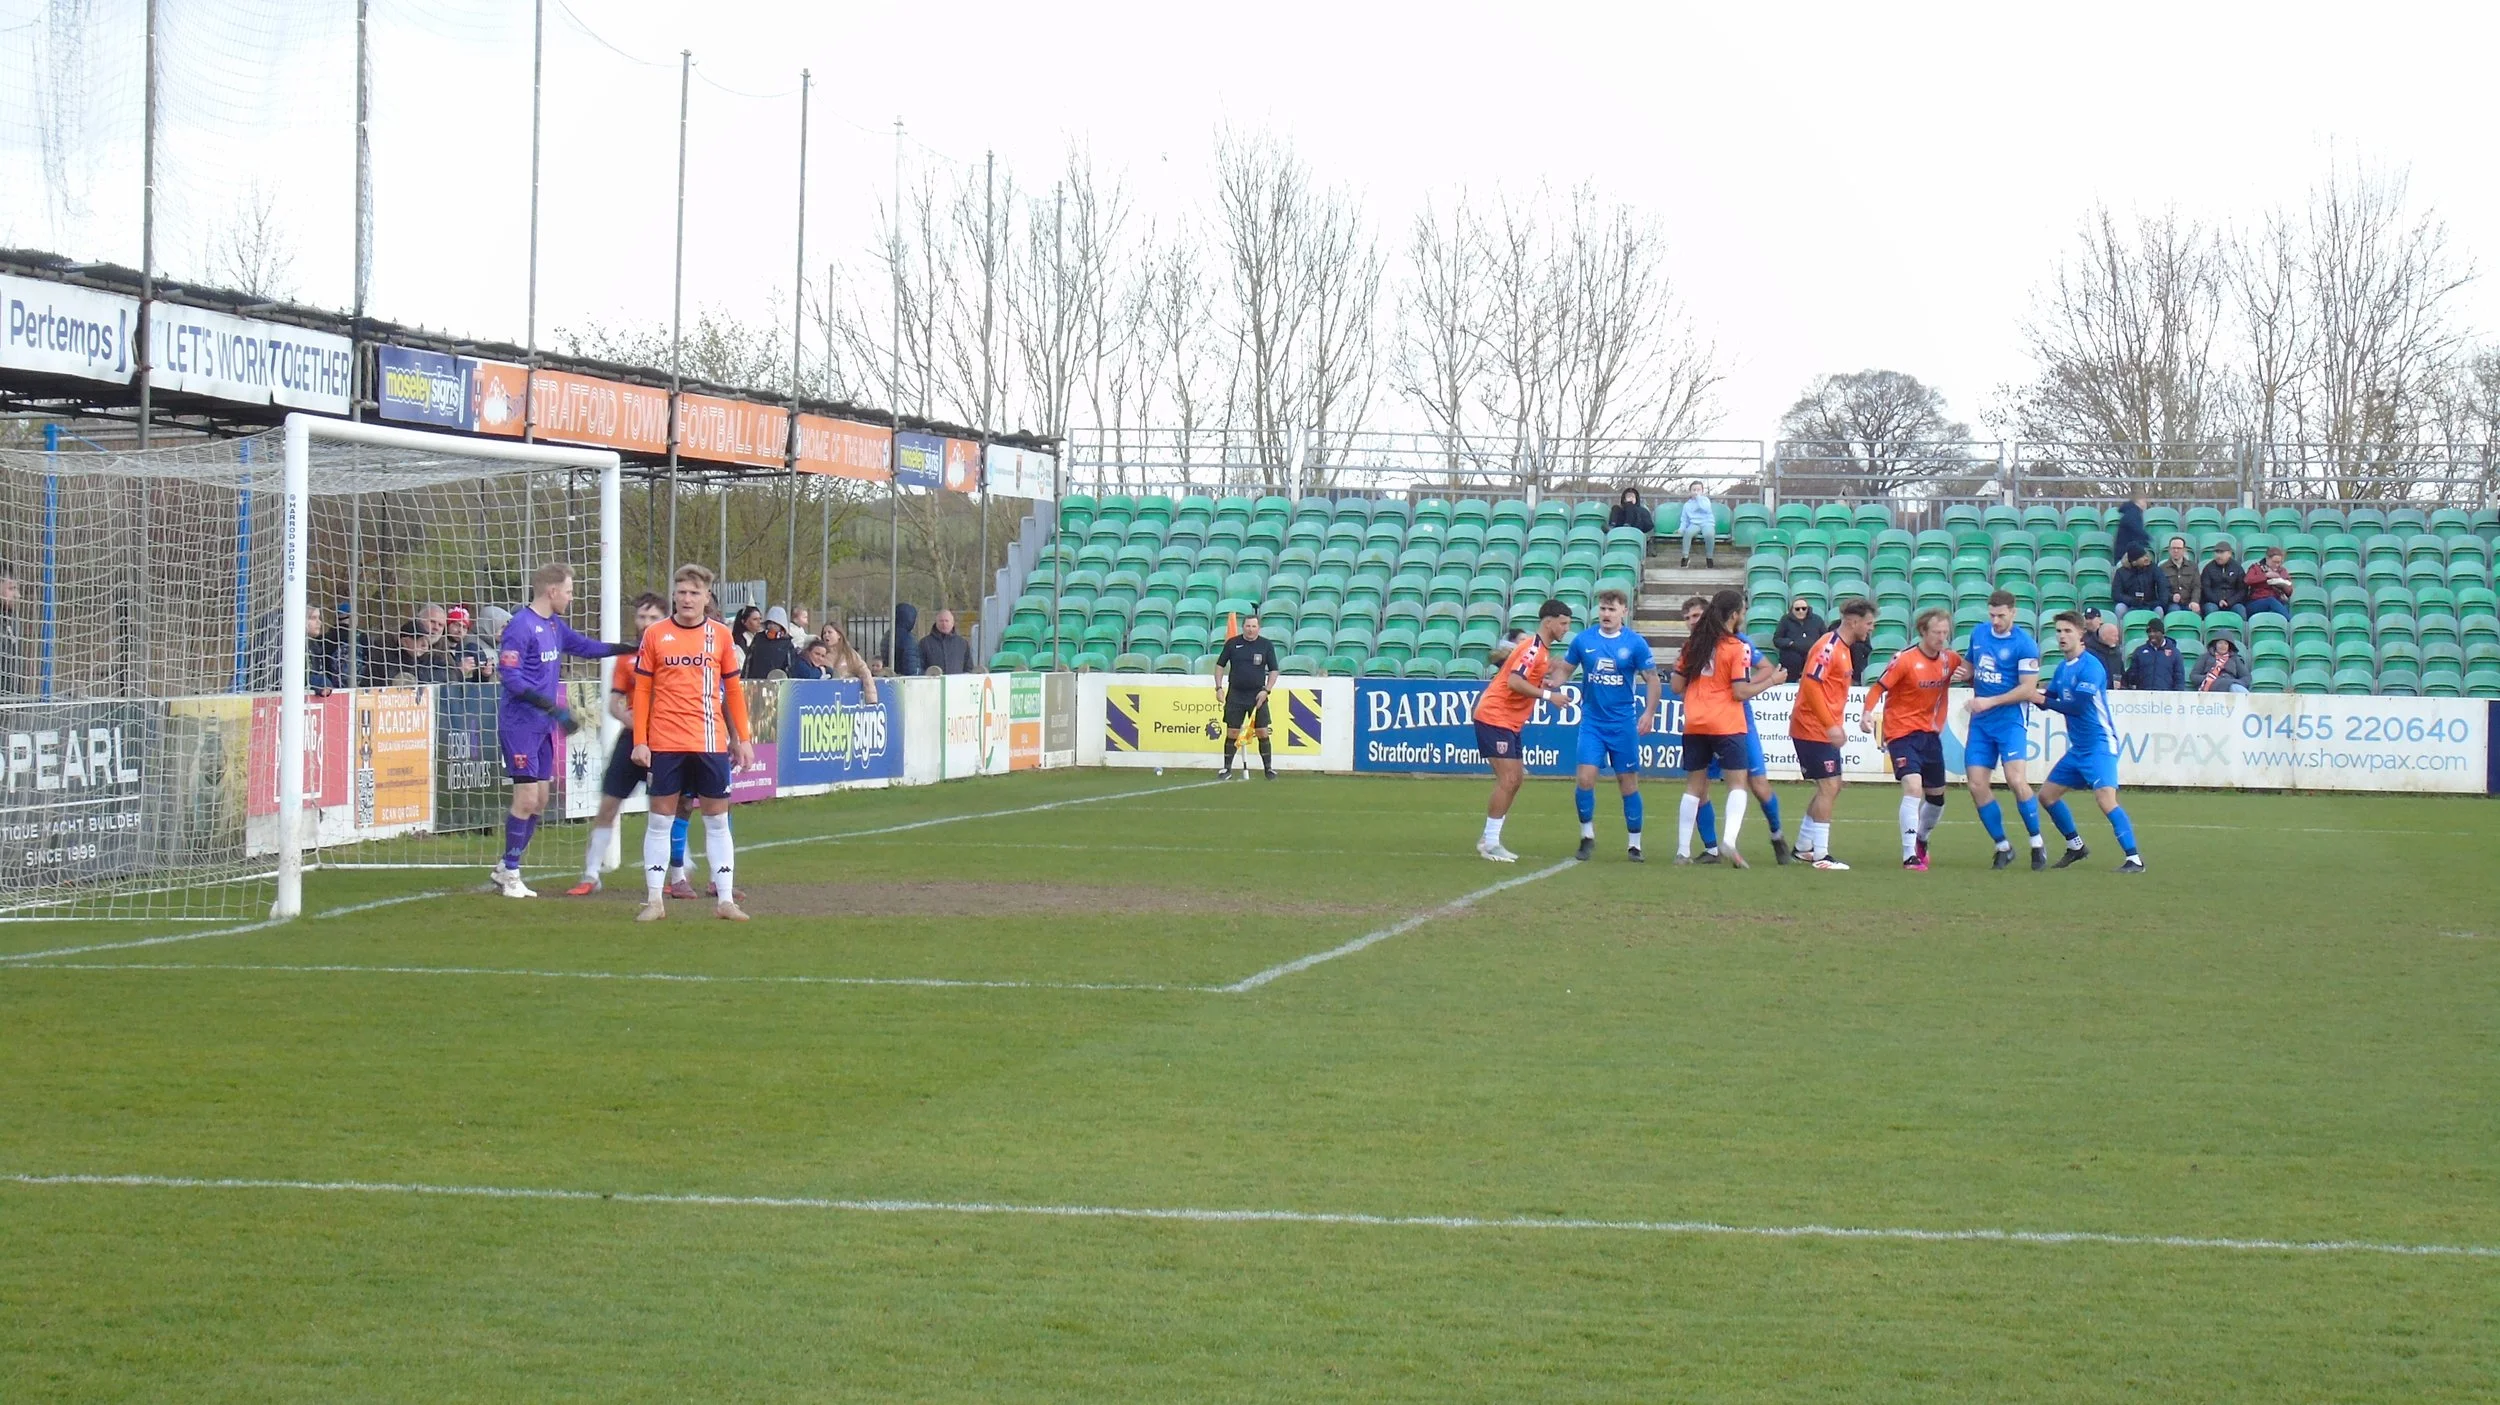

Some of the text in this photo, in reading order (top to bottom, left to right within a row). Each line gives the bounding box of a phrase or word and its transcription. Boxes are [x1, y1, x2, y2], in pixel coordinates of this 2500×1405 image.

[10, 299, 113, 367] Pertemps
[167, 321, 350, 397] LET'S WORK TOGETHER
[386, 368, 431, 408] moseley
[431, 371, 460, 411] signs
[532, 378, 617, 438] STRATFORD
[623, 392, 672, 446] TOWN
[679, 399, 790, 461] FOOTBALL CLUB
[801, 427, 829, 463] HOME
[831, 433, 841, 464] OF
[843, 434, 858, 466] THE
[288, 541, 296, 574] SPORT
[665, 653, 712, 667] wodr
[1588, 673, 1624, 685] FOSSE
[1173, 700, 1223, 713] Support
[1367, 690, 1480, 731] BARRY
[2109, 700, 2235, 718] possible a reality
[377, 709, 427, 734] ACADEMY
[801, 698, 886, 762] moseley signs
[947, 714, 979, 745] FANTASTIC
[1154, 722, 1201, 734] Premier
[2242, 713, 2469, 743] 01455 220640
[447, 732, 471, 759] DESIGN
[1368, 740, 1442, 764] Stratford's
[1445, 743, 1490, 765] Prem
[1522, 744, 1560, 766] tcher
[1656, 745, 1684, 768] 267
[2242, 748, 2467, 773] www.showpax.com
[43, 818, 85, 836] YACHT
[89, 812, 142, 832] BUILDER
[382, 807, 397, 821] SCAN
[26, 844, 97, 867] SINCE 1998
